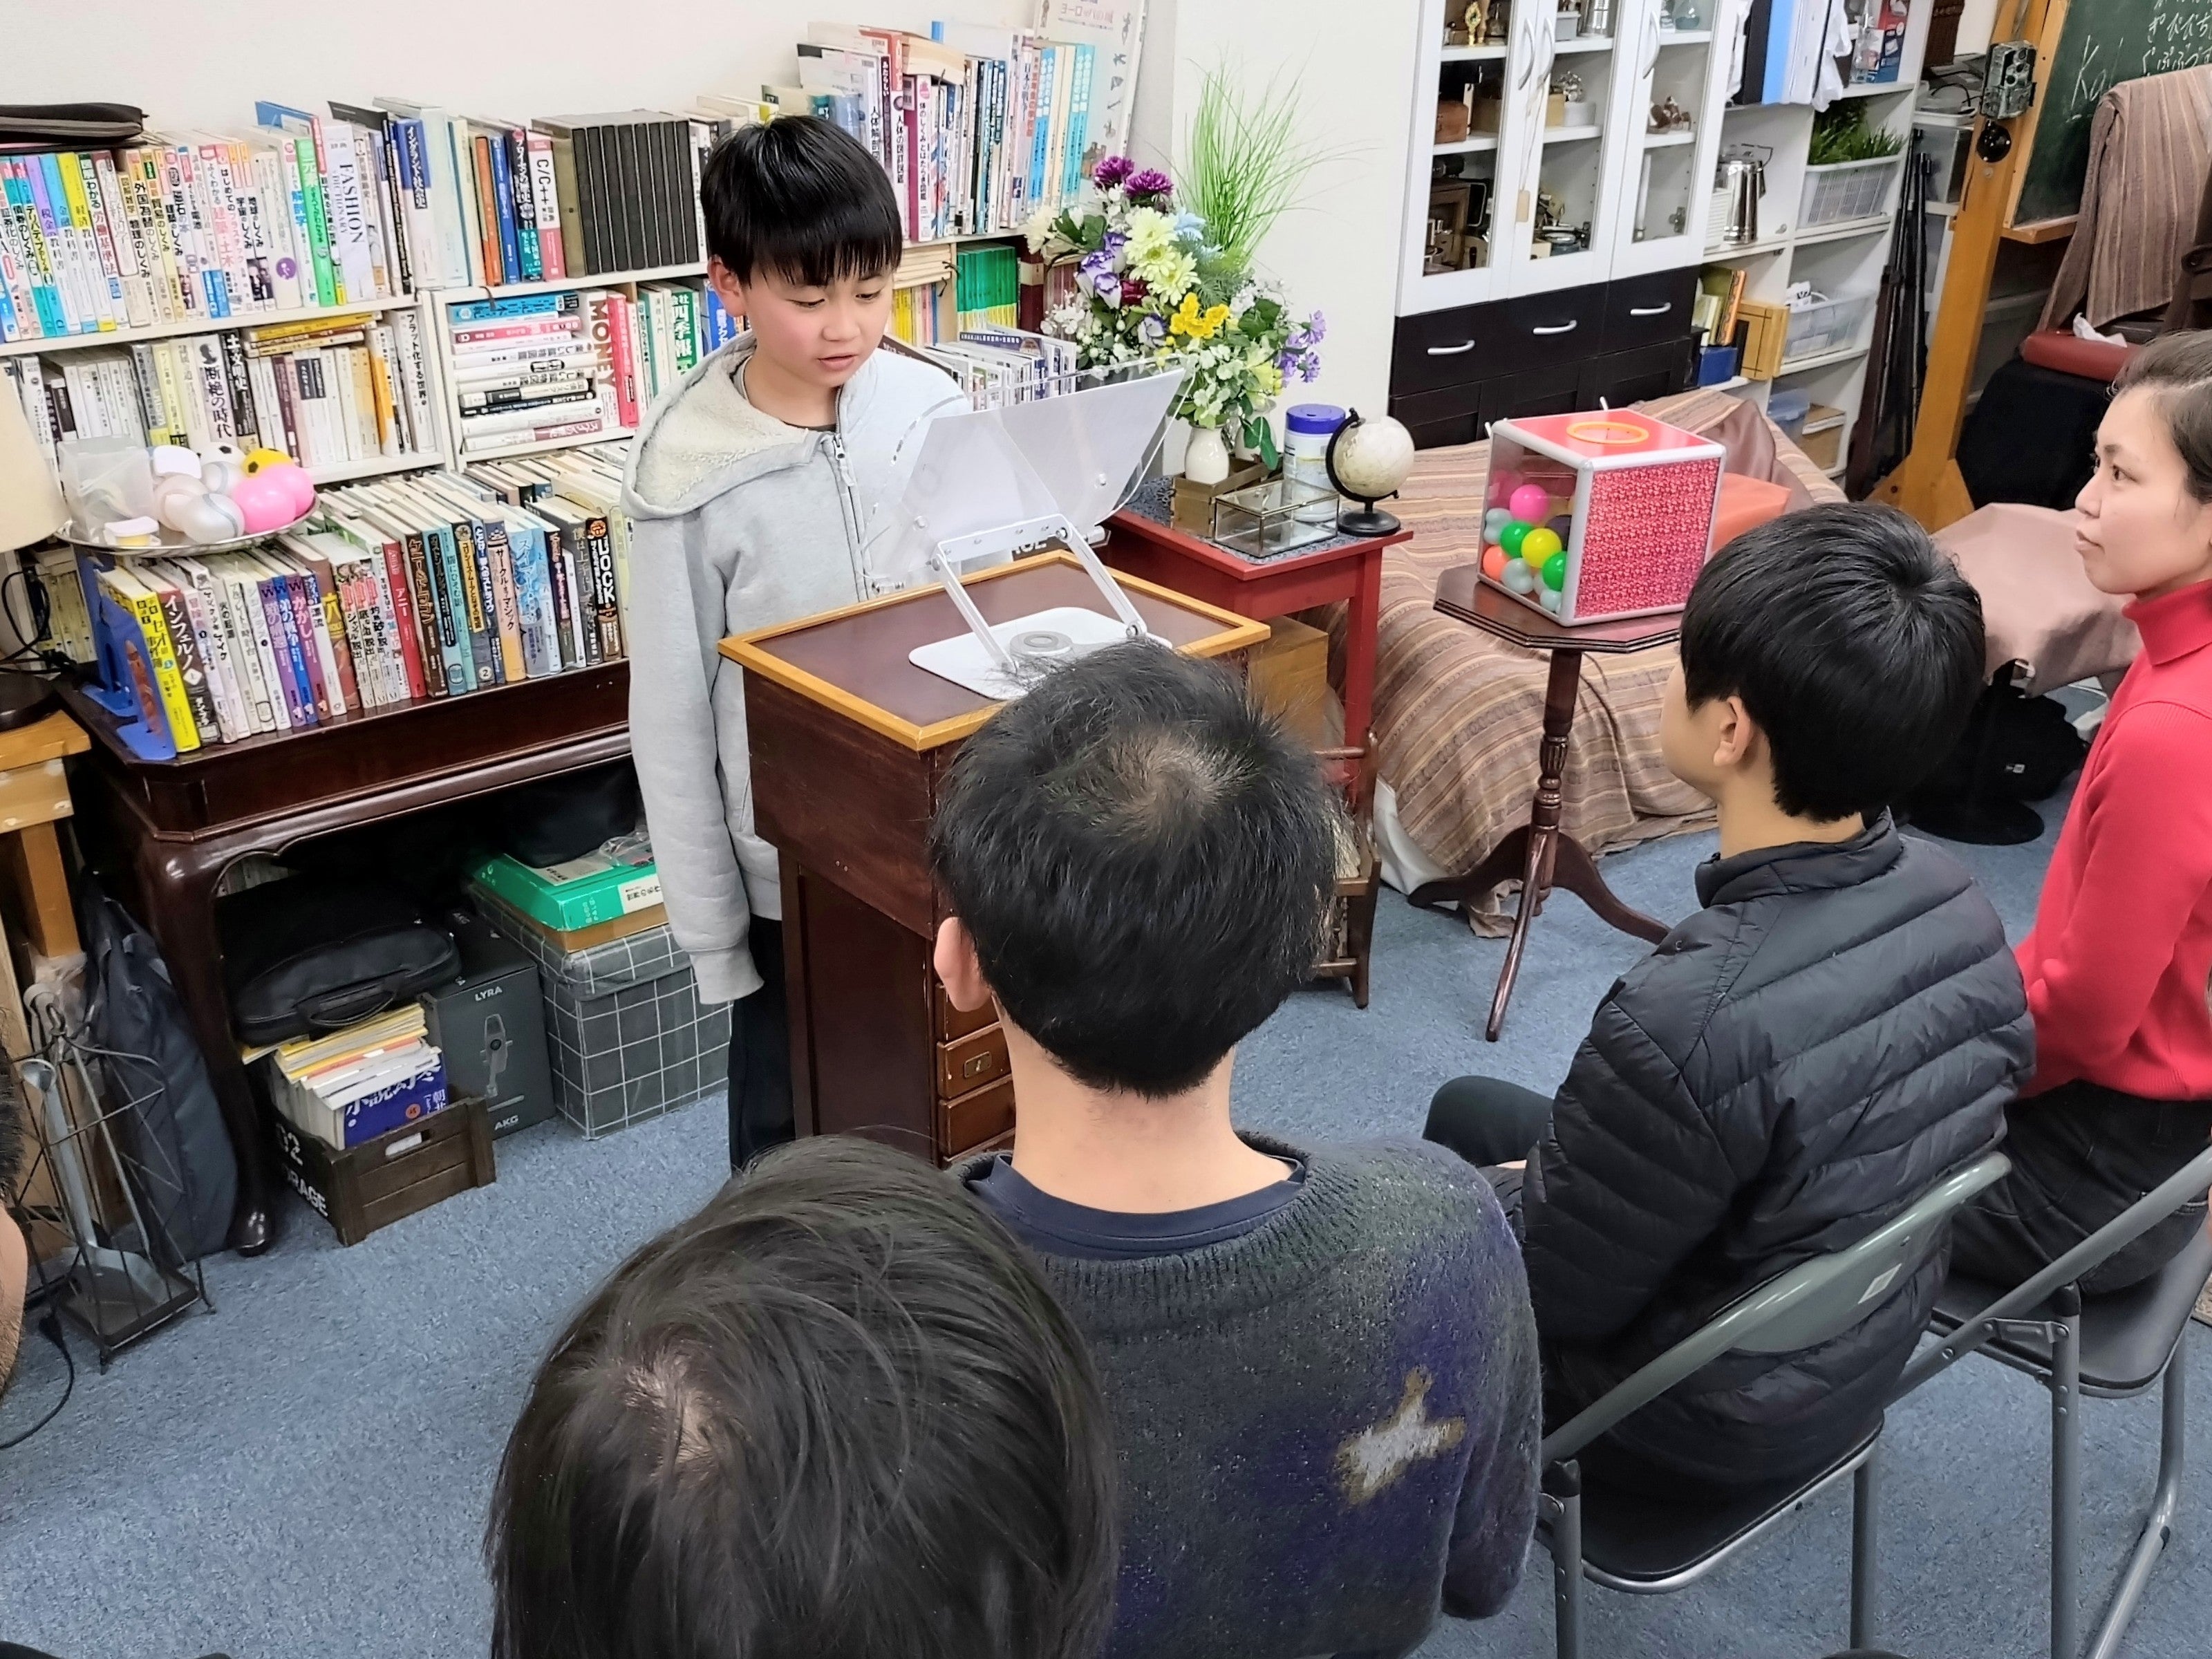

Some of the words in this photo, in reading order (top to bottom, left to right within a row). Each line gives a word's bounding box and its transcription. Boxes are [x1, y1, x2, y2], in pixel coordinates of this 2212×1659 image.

[339, 163, 365, 244] FASHION
[536, 158, 552, 205] C/C++
[590, 299, 617, 388] MONEY
[598, 538, 616, 604] LOCK
[292, 597, 312, 639] かかし
[395, 588, 409, 617] アニー
[165, 594, 194, 671] インフェルノ
[474, 985, 503, 1002] LYRA
[494, 1114, 519, 1131] AKG
